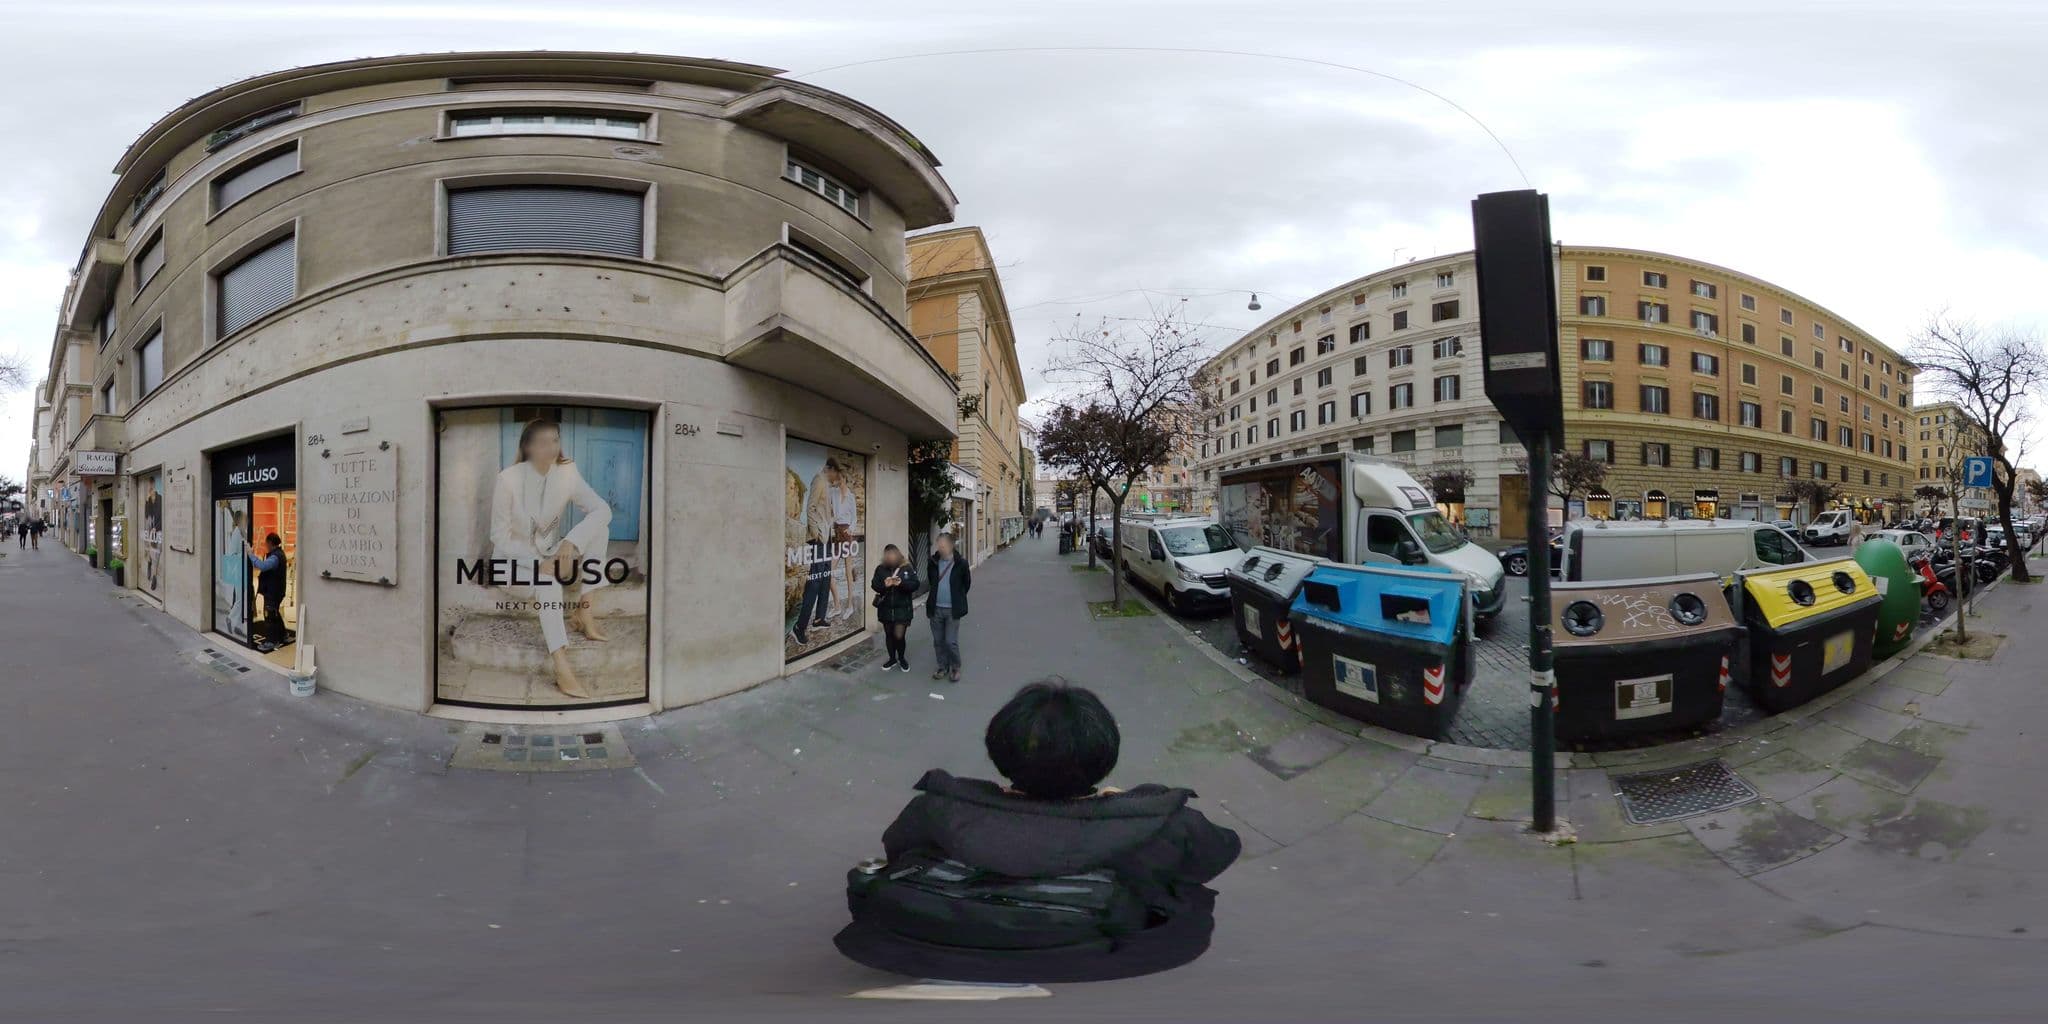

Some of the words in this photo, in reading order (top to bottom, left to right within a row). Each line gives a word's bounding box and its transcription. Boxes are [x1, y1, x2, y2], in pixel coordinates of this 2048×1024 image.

[307, 433, 325, 446] 284
[86, 454, 114, 462] RAGGI
[247, 453, 256, 467] M
[332, 459, 377, 475] TUTTE
[1968, 459, 1986, 484] P
[229, 467, 278, 485] MELLUSO
[344, 476, 361, 489] LE
[318, 489, 396, 505] OPERAZIONI
[347, 507, 361, 519] DI
[329, 522, 378, 537] BANCA
[328, 538, 383, 552] CAMBIO
[331, 553, 377, 569] BORSA
[787, 540, 859, 567] MELLUSO
[456, 557, 630, 586] MELLUSO
[495, 601, 528, 610] NEXT
[533, 601, 591, 610] OPENING
